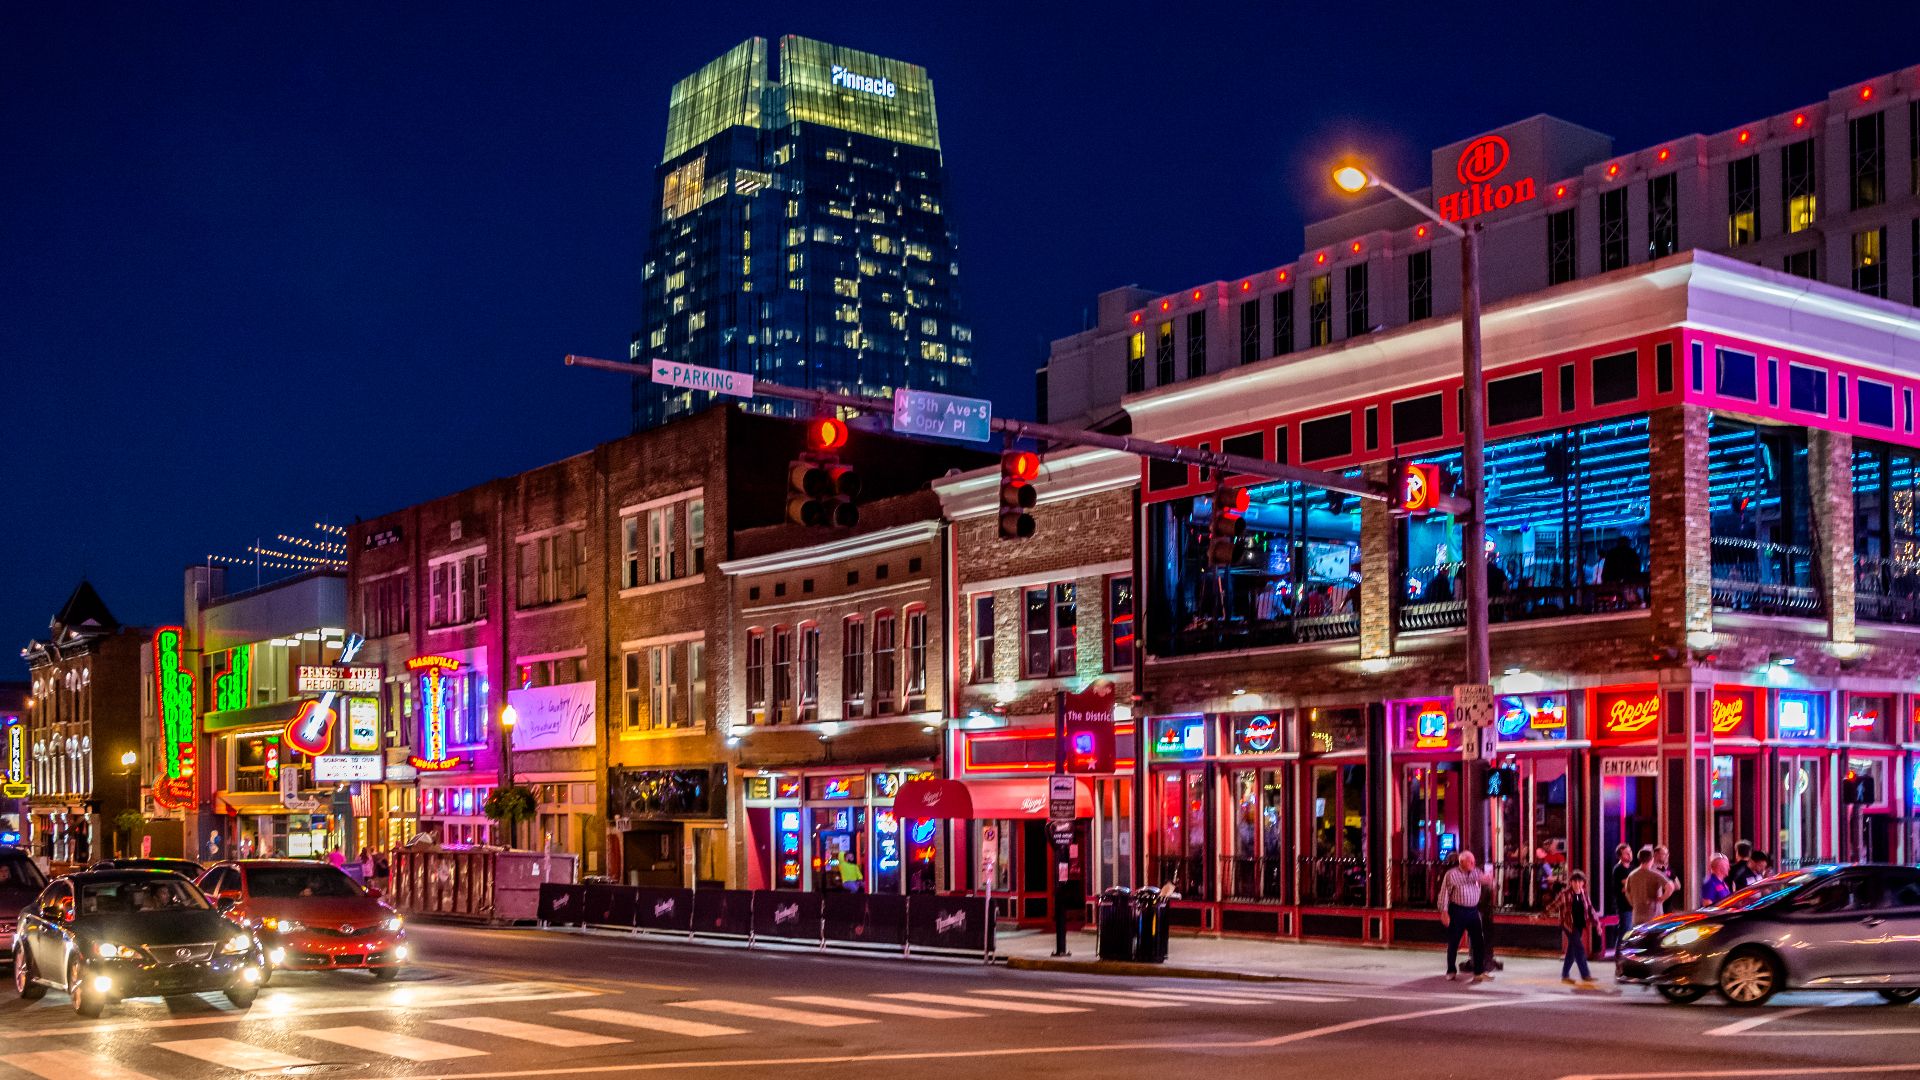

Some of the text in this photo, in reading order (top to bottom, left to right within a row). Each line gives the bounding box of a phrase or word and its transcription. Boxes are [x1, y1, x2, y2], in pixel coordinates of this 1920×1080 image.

[832, 64, 896, 98] Pinnacle
[1438, 177, 1536, 222] Hilton
[673, 366, 733, 391] PARKING
[916, 413, 966, 433] Opry Pl
[408, 656, 460, 670] NASHVILLE
[300, 666, 380, 680] ERNEST TUBB
[306, 679, 374, 691] RECORD SHOP
[1067, 710, 1113, 721] The Distric
[1456, 706, 1472, 721] OK
